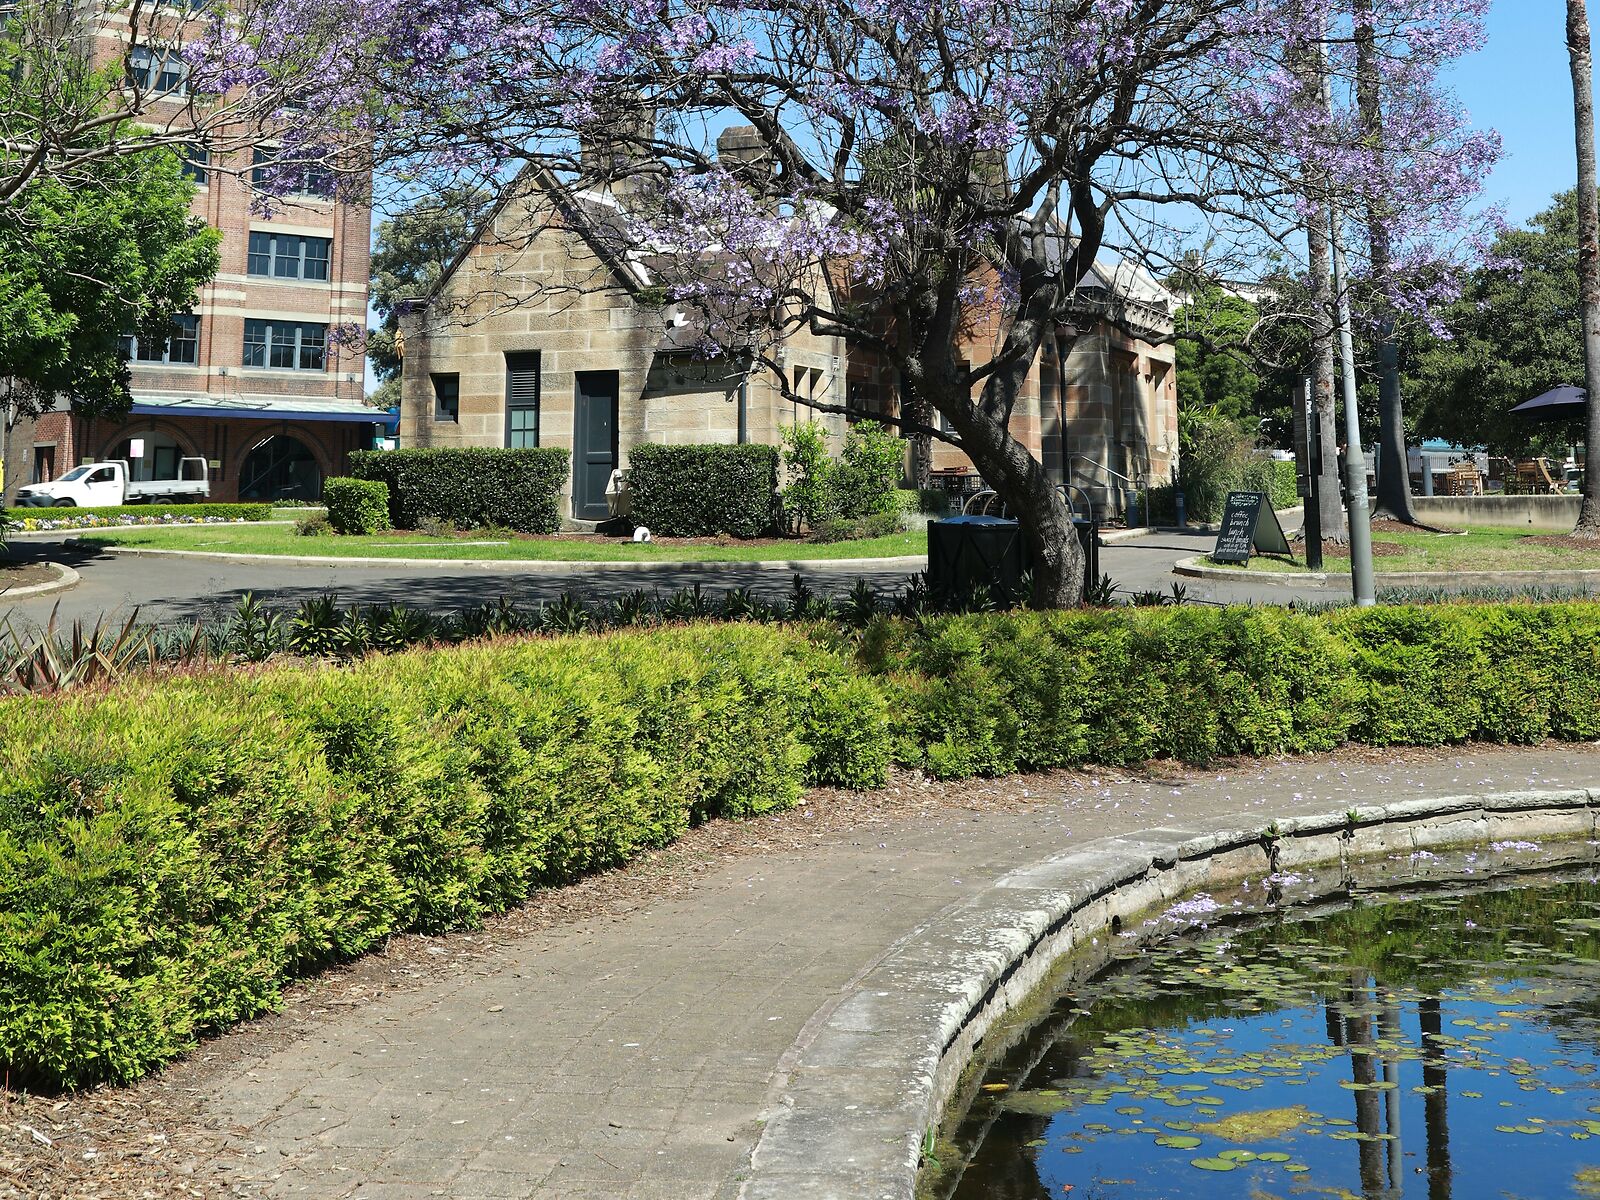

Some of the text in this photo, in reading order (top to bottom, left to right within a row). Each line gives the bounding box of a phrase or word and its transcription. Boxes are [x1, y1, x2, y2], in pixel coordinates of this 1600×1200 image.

[1230, 510, 1249, 519] coffee
[1229, 517, 1250, 527] brunch
[1228, 527, 1245, 537] lunch
